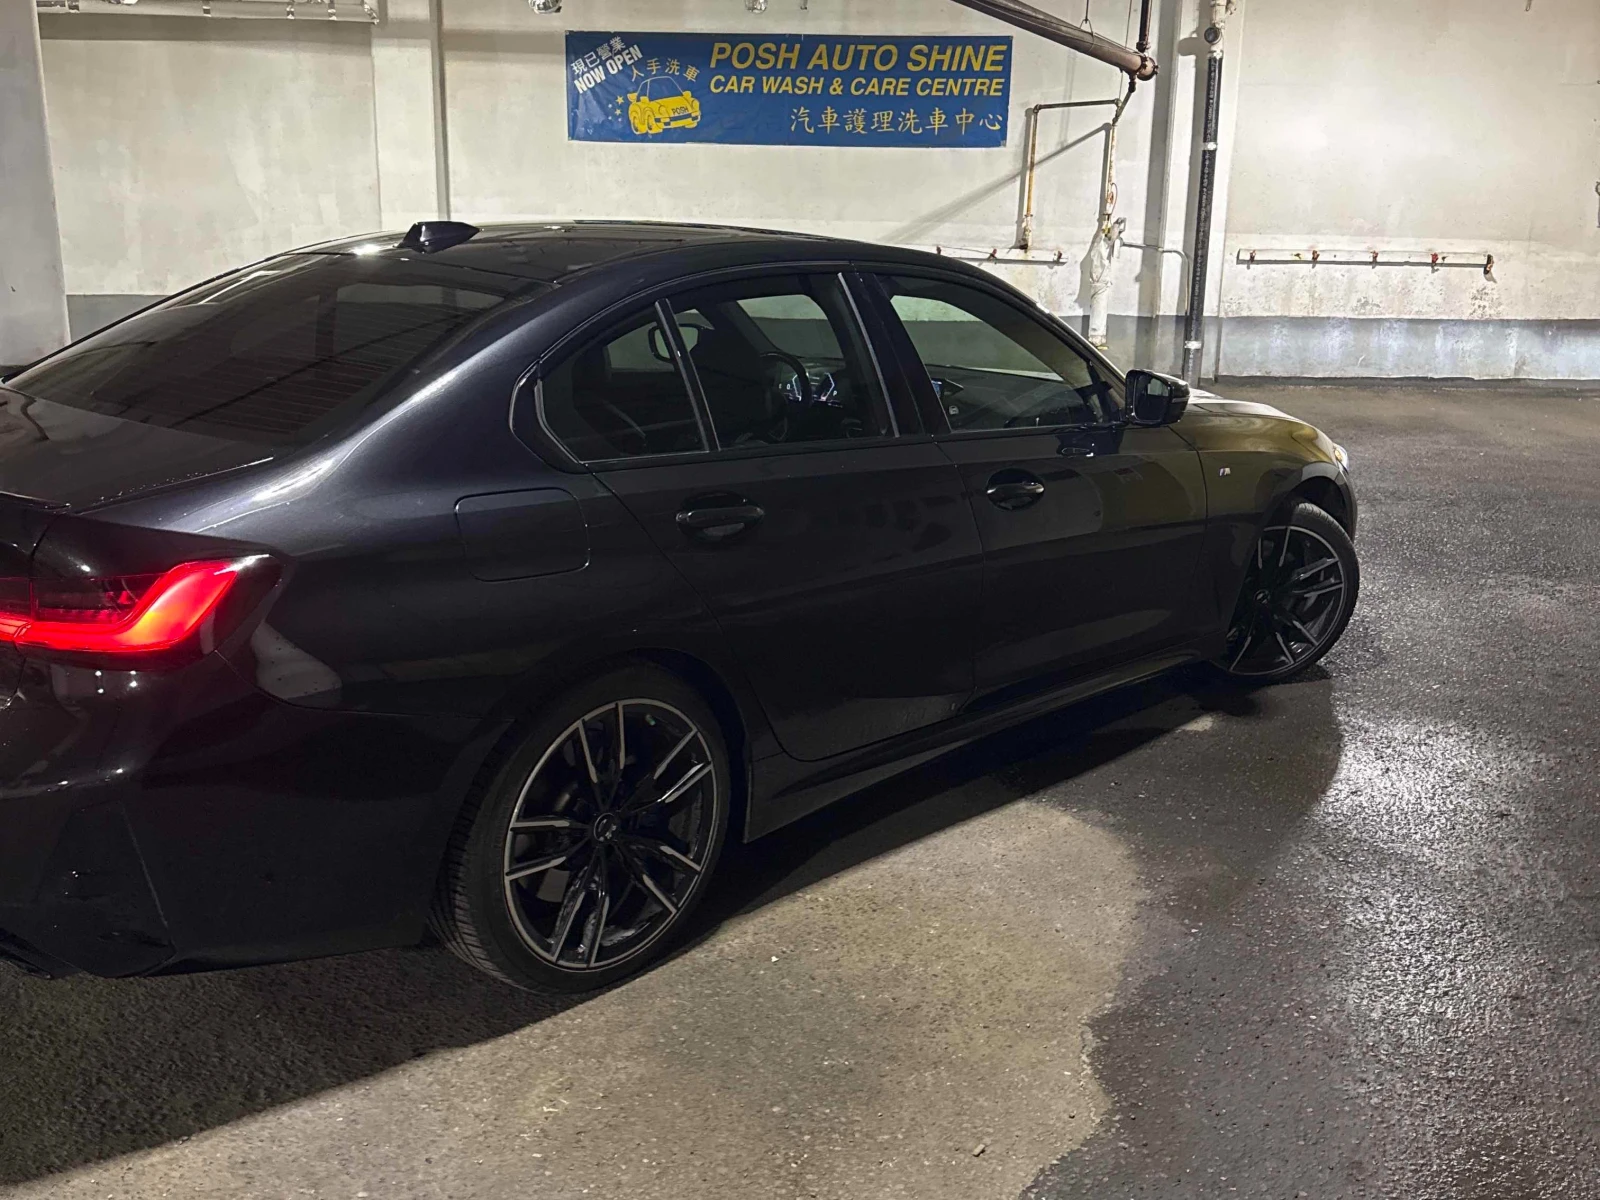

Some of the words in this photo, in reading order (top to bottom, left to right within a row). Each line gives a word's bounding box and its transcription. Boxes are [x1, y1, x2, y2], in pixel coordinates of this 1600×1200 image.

[571, 36, 626, 75] 現已營業
[574, 65, 606, 94] NOW
[606, 44, 643, 75] OPEN
[631, 58, 700, 82] 人手洗車
[709, 42, 801, 70] POSH
[806, 43, 899, 71] AUTO
[906, 44, 1008, 72] SHINE
[709, 75, 756, 94] CAR
[762, 76, 825, 95] WASH
[829, 77, 844, 96] &
[850, 77, 912, 96] CARE
[916, 78, 1005, 96] CENTRE
[671, 105, 690, 116] POSH
[790, 105, 1004, 137] 汽車護理洗車中心
